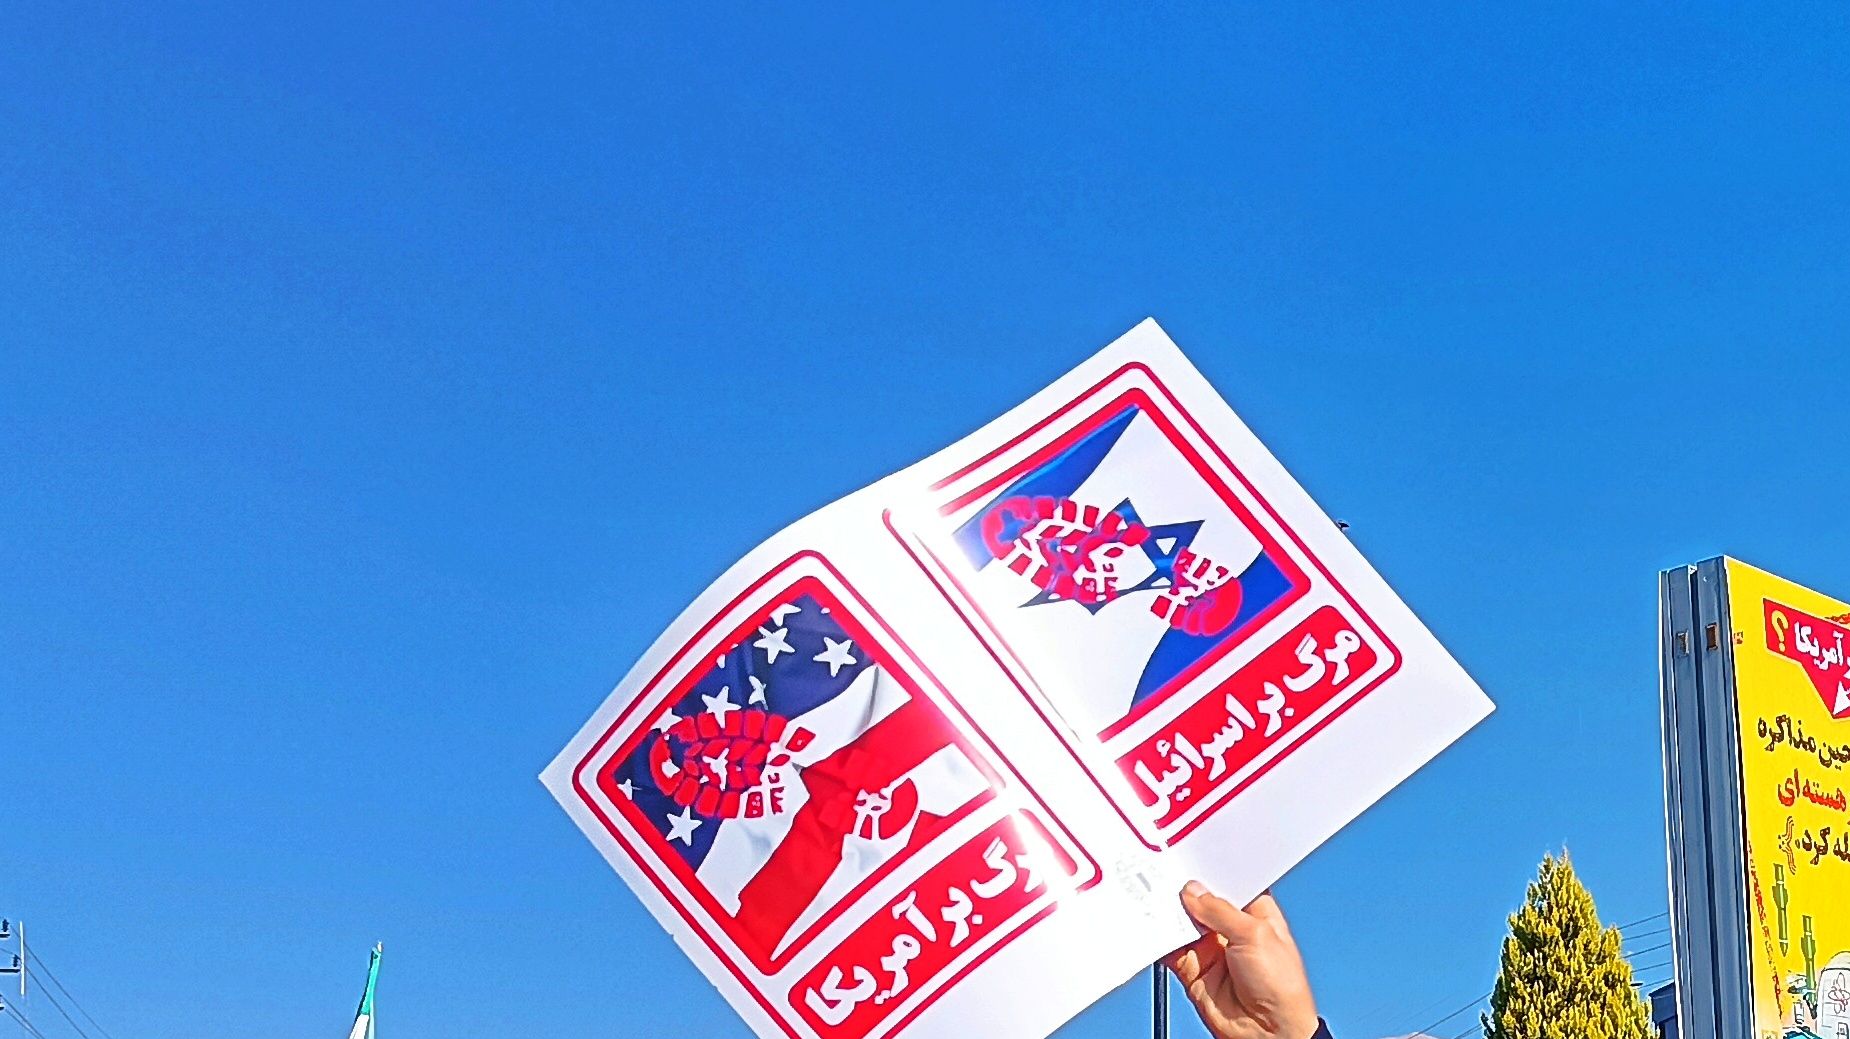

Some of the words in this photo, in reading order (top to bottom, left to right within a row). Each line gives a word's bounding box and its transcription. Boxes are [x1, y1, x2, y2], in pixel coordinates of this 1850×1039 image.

[1283, 626, 1365, 695] مرگ
[1793, 622, 1845, 672] آمریکا
[1237, 677, 1285, 741] بر
[1756, 714, 1818, 753] مذاکره
[1138, 687, 1253, 820] اسرائیل
[969, 836, 1060, 900] رگ
[940, 880, 988, 943] بر
[806, 890, 942, 1024] آمریکا
